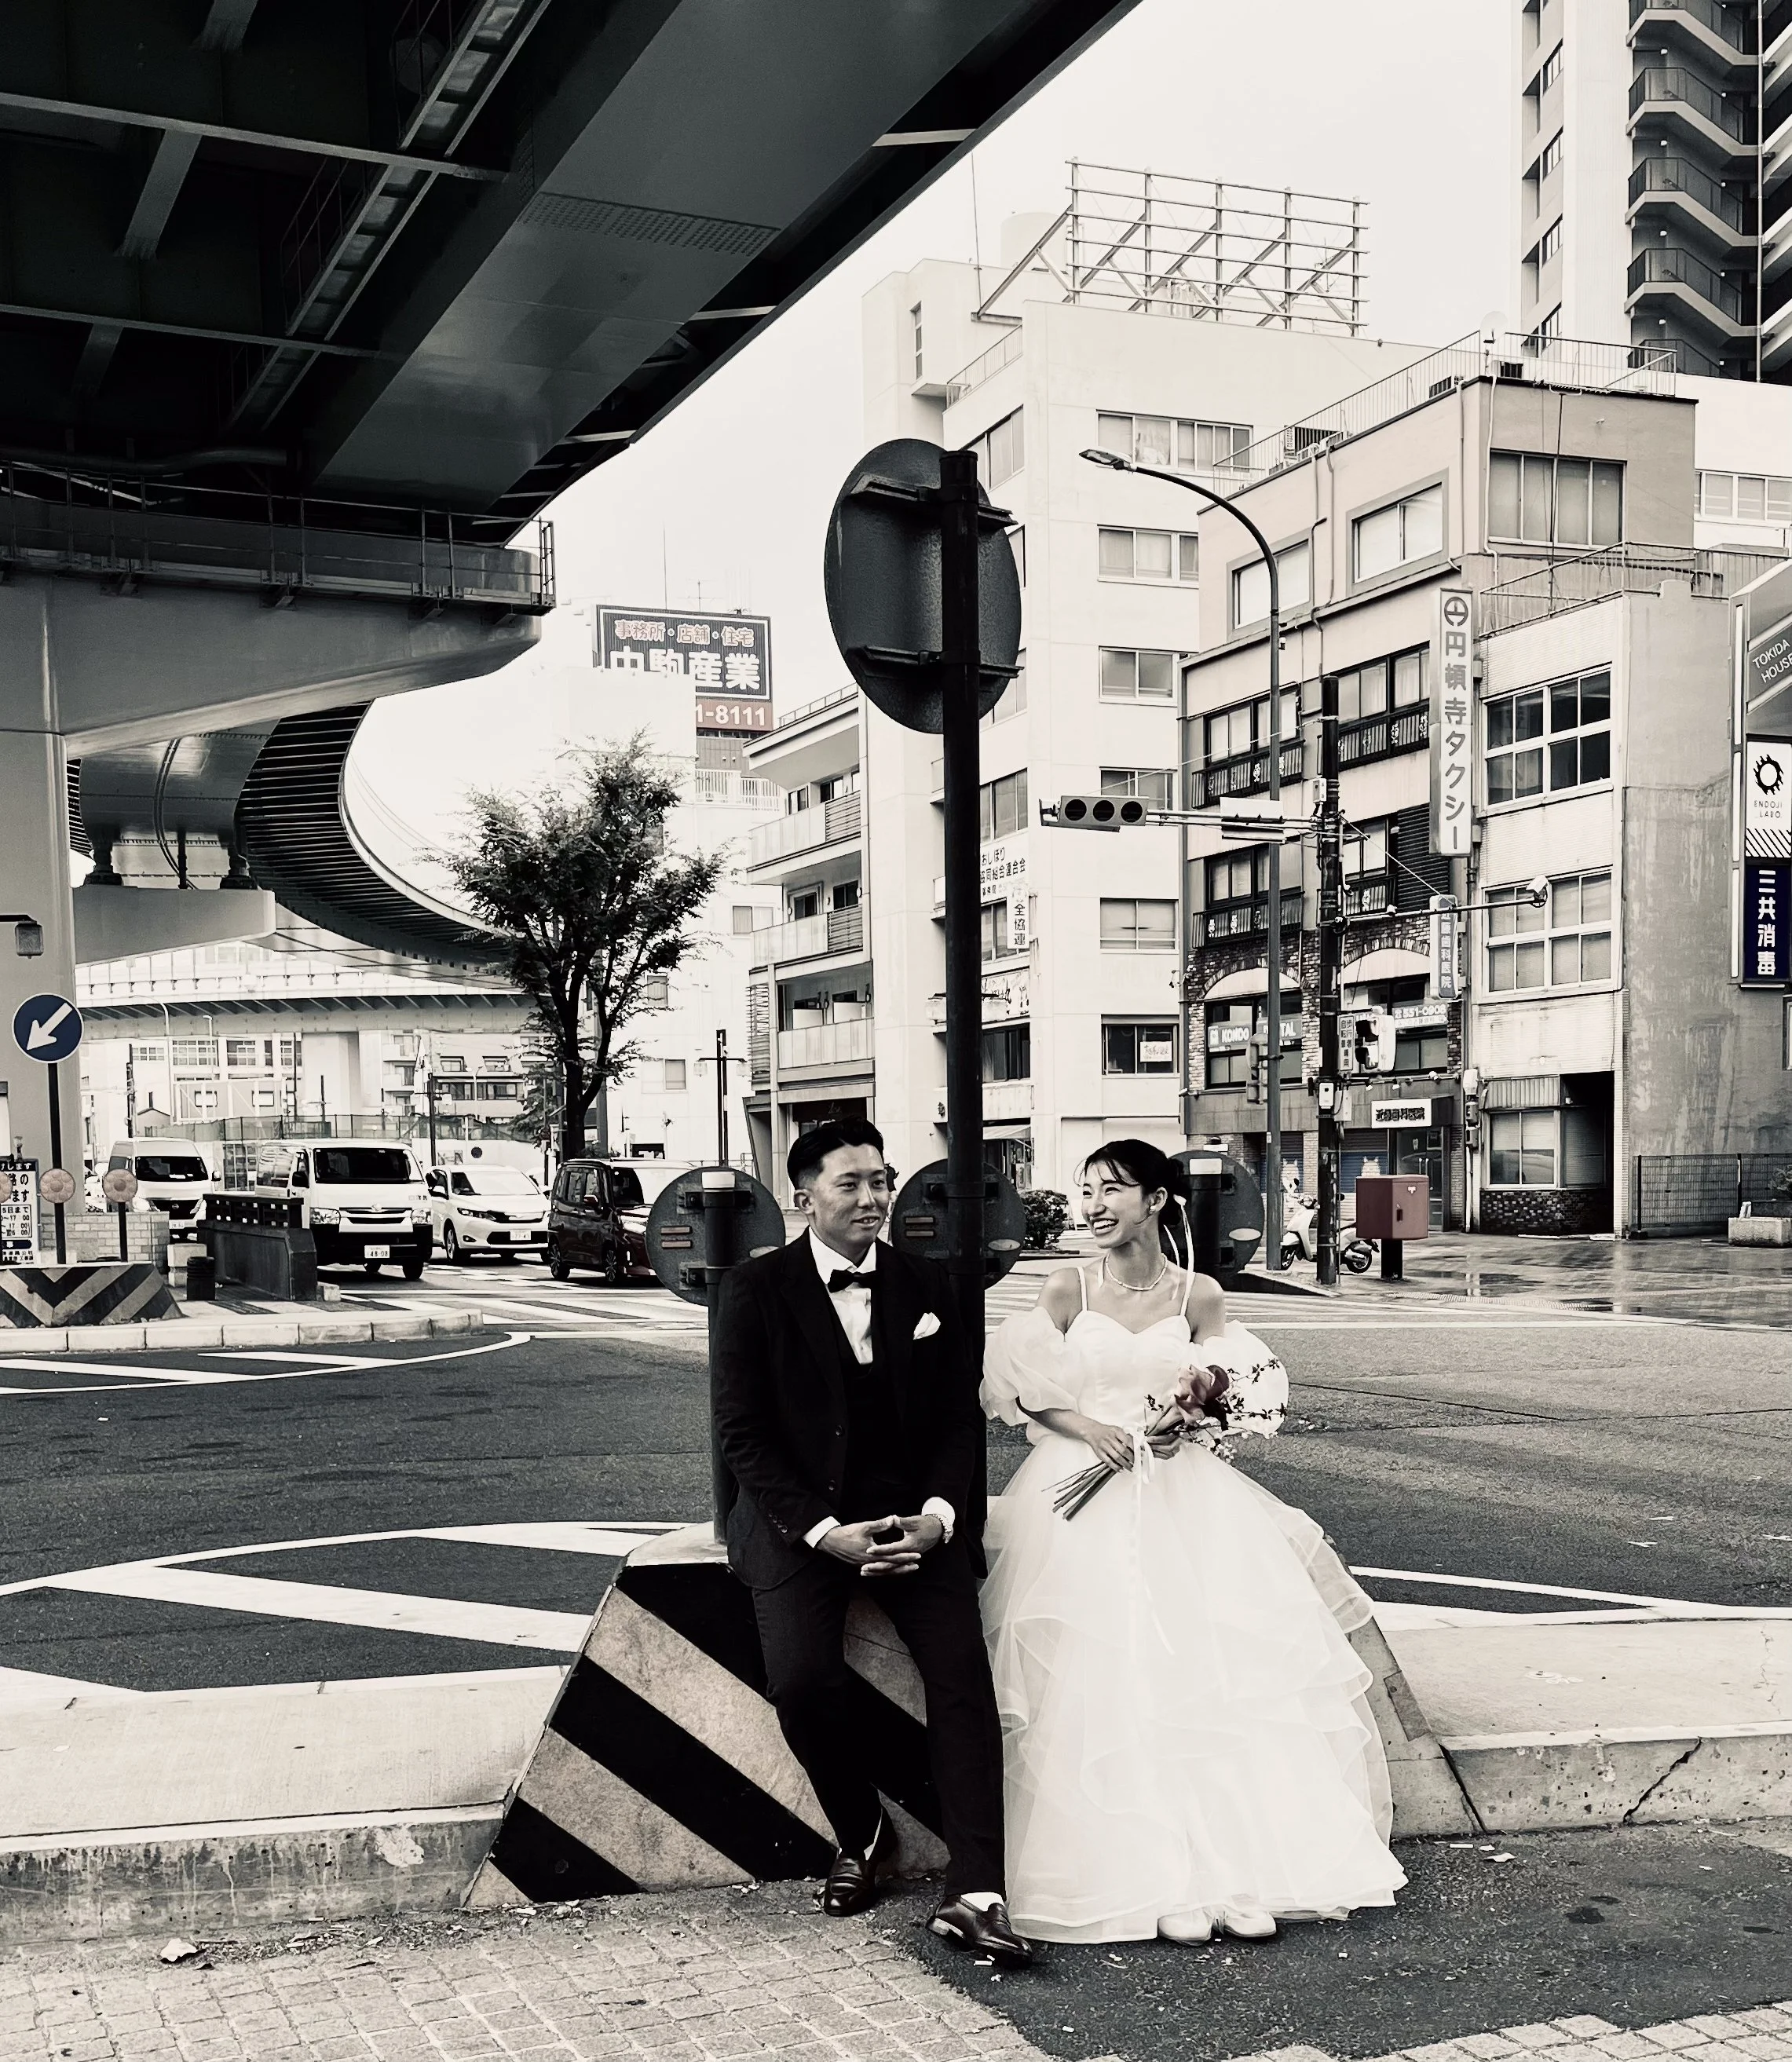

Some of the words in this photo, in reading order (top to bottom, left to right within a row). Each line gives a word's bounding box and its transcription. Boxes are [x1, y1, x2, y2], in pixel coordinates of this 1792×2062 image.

[1752, 639, 1791, 669] TOKIDA
[1444, 631, 1468, 850] 円頓寺タクシー
[1754, 800, 1783, 809] ENDOJI
[1014, 903, 1026, 945] 全協連
[1757, 869, 1777, 977] 三共消毒
[1221, 1027, 1250, 1044] KONDO
